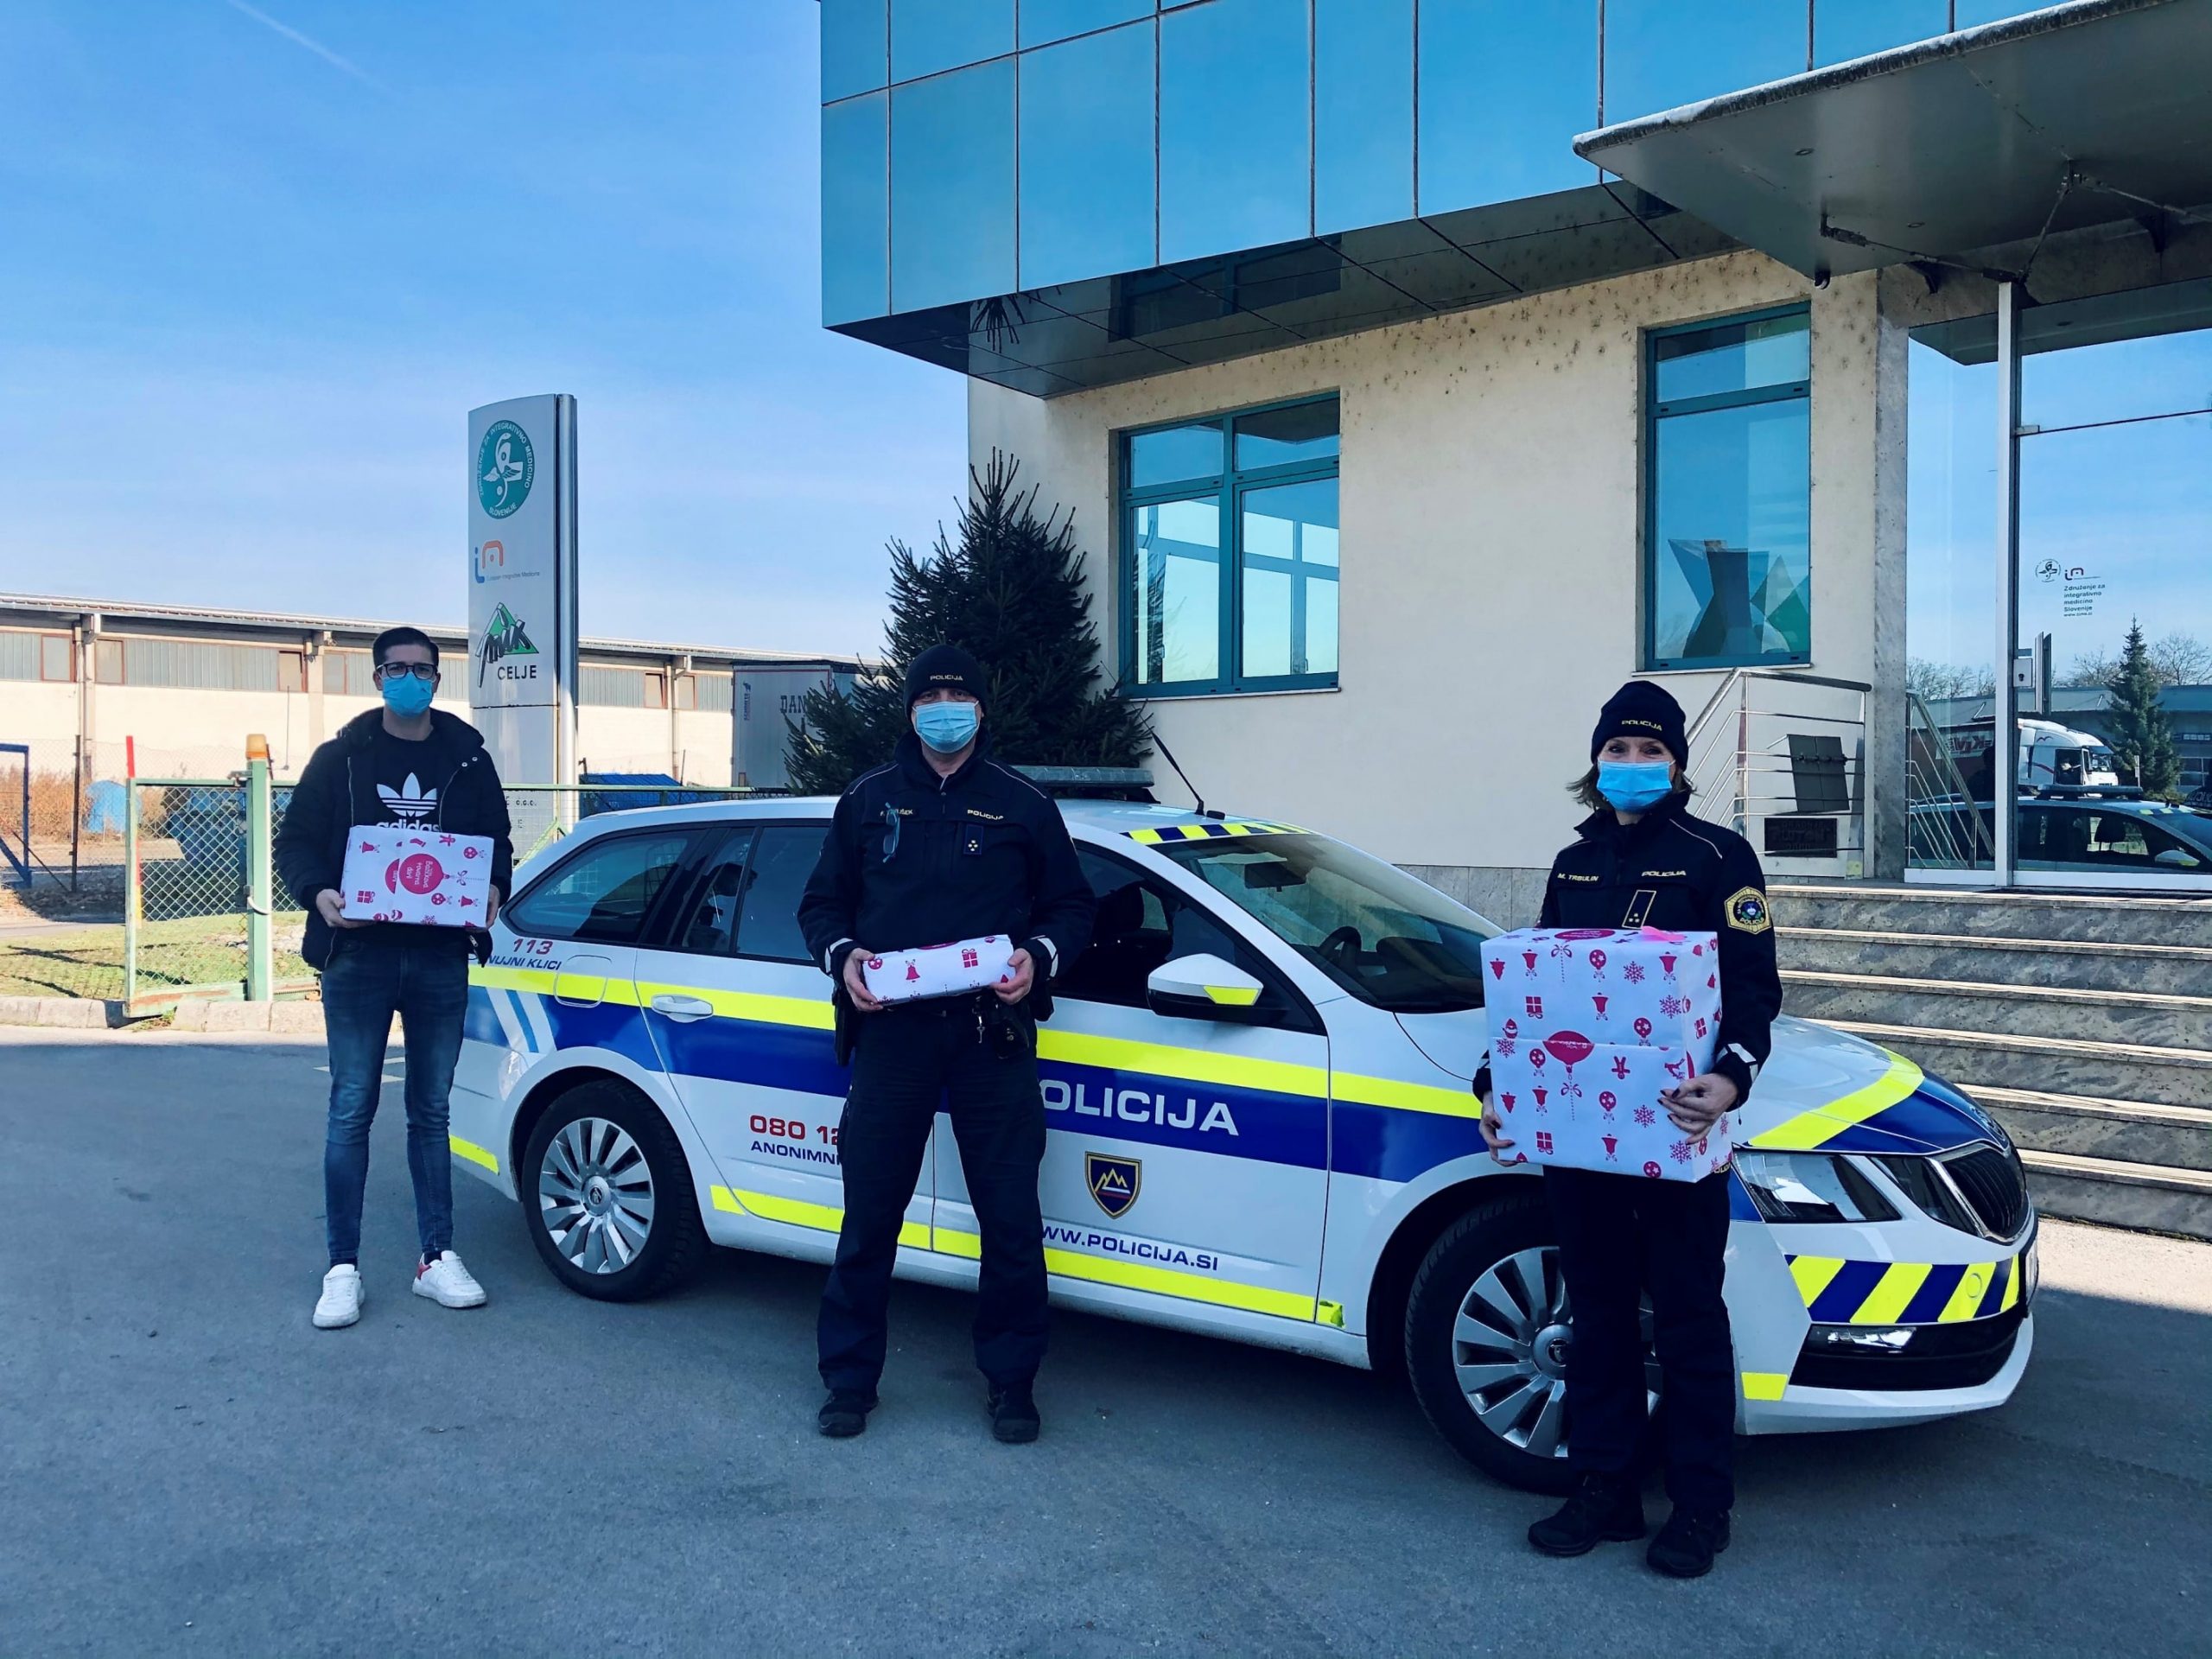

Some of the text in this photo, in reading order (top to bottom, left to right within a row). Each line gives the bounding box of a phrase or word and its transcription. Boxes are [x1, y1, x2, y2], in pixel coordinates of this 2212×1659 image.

[524, 445, 533, 489] MEDICINO
[497, 664, 537, 680] CELJE
[1621, 719, 1662, 731] POLICIJA
[967, 809, 1004, 820] POLICIJA
[513, 938, 554, 955] 113
[526, 958, 562, 970] KLICI
[1039, 1079, 1239, 1136] OLICIJA
[750, 1115, 805, 1140] 080
[1043, 1225, 1218, 1271] WW.POLICIJA.SI
